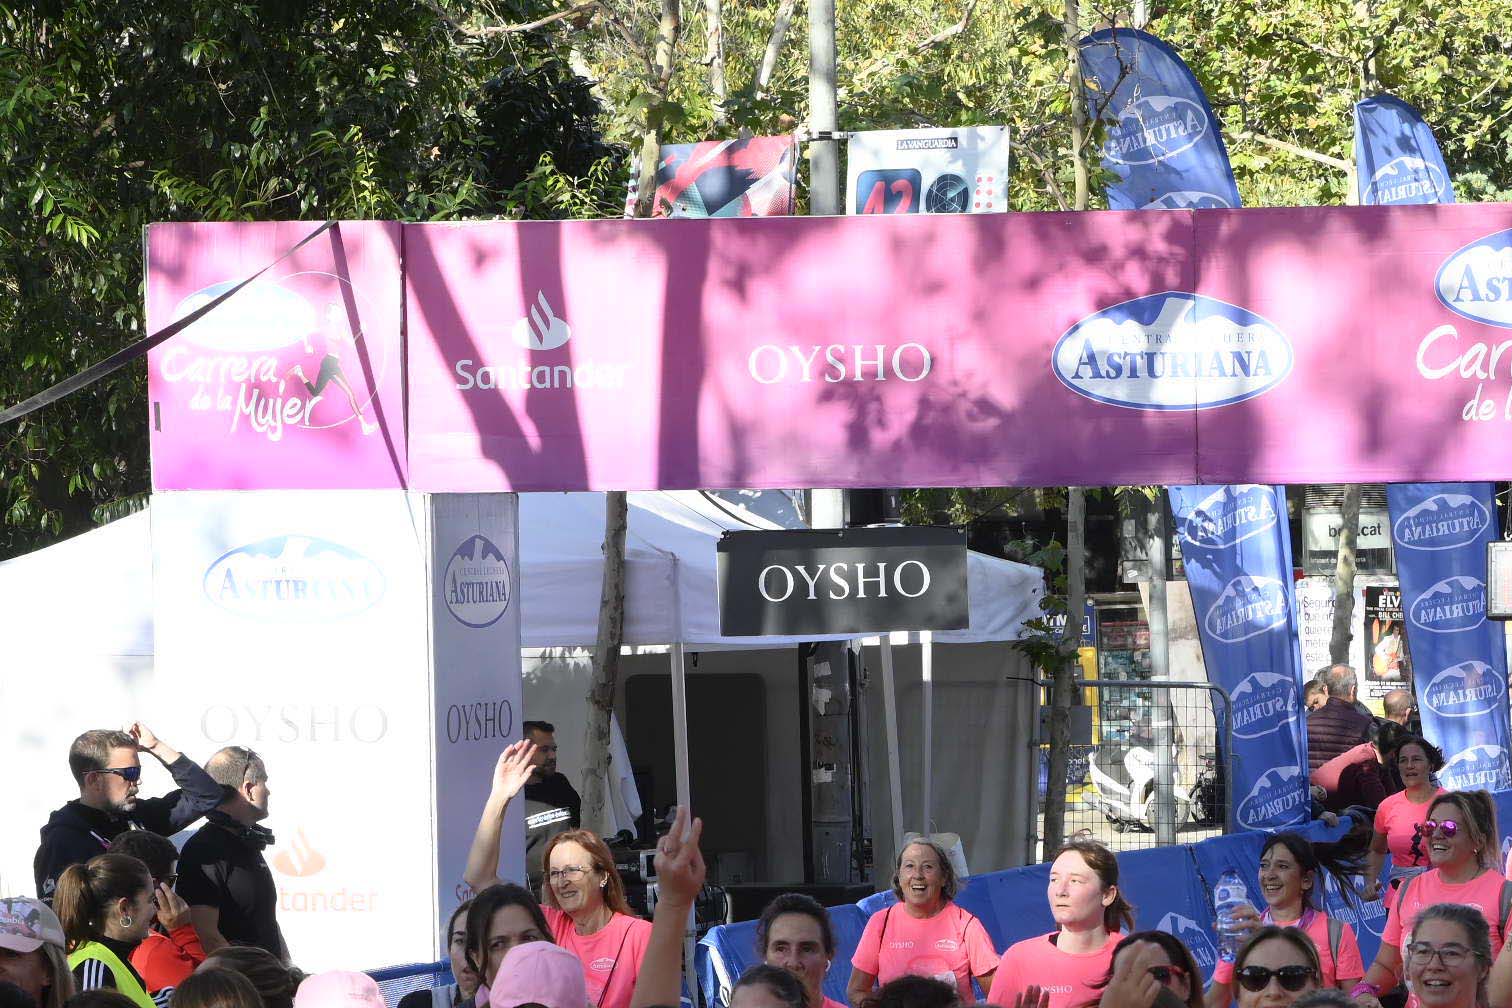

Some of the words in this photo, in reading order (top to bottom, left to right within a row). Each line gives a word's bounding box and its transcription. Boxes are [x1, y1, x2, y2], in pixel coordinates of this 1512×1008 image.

[908, 138, 957, 150] VANGUARDIA
[159, 346, 278, 383] Carrera
[455, 359, 628, 390] Santander
[748, 342, 932, 385] OYSHO
[1070, 337, 1273, 381] ASTURIANA
[230, 380, 324, 441] Mujer
[1462, 382, 1497, 421] de
[1328, 522, 1382, 537] b.cat
[449, 569, 507, 605] ASTURIANA
[758, 560, 931, 602] OYSHO
[447, 700, 513, 744] OYSHO
[278, 885, 378, 912] tander
